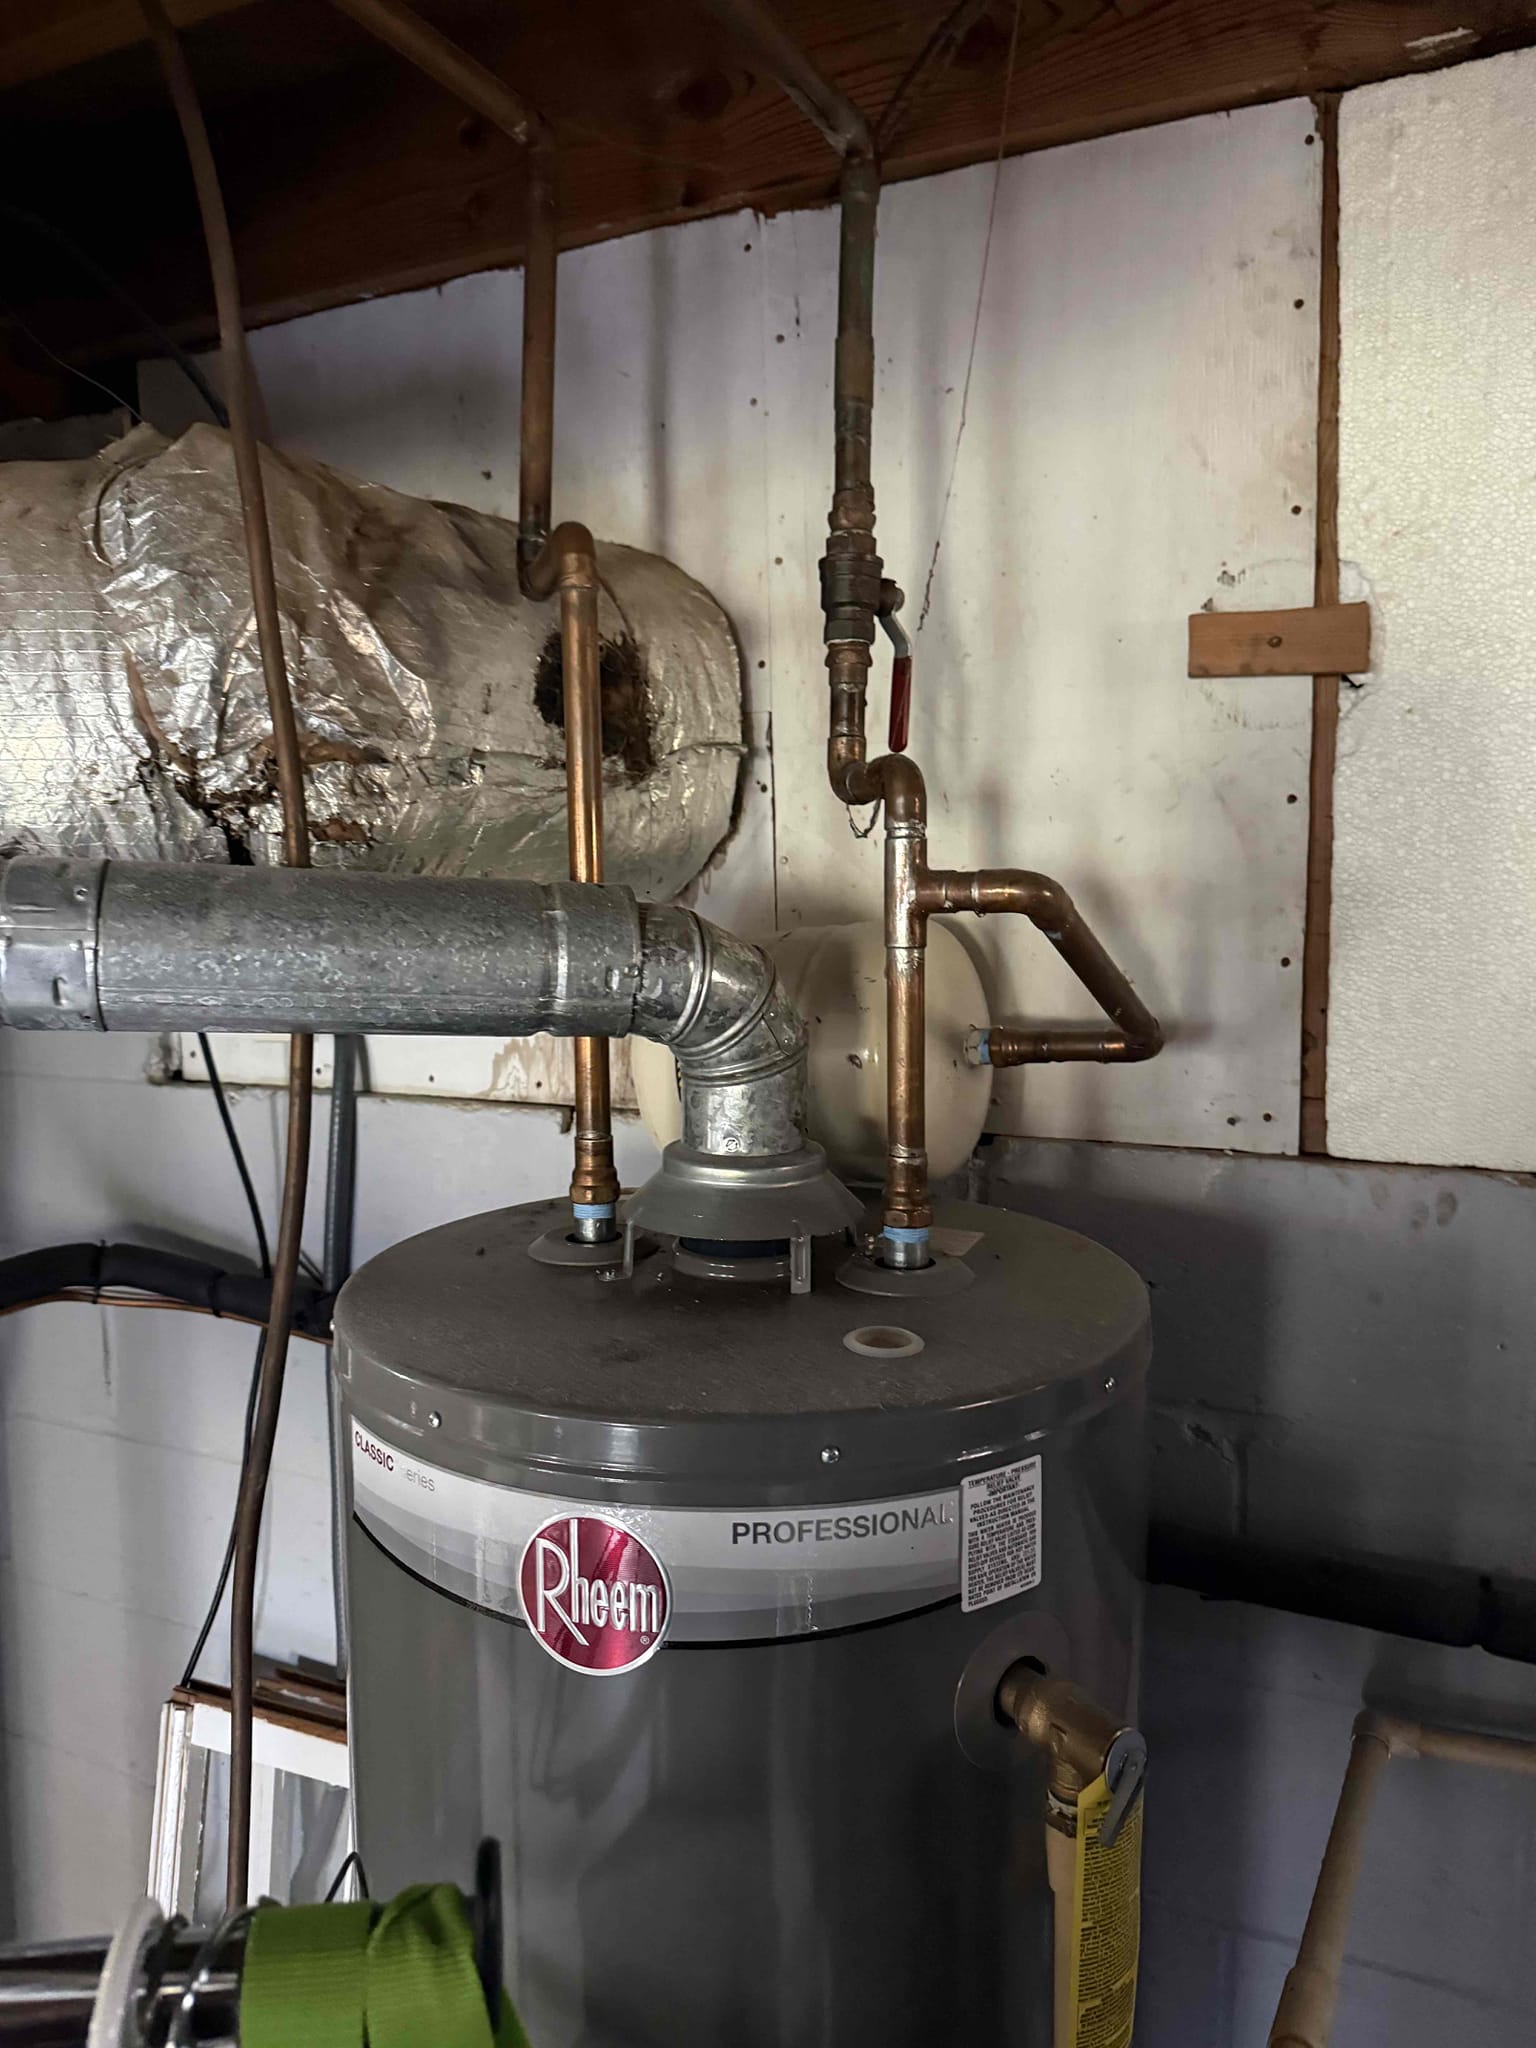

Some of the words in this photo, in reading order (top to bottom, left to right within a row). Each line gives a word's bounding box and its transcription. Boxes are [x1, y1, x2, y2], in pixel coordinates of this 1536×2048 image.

[354, 1431, 394, 1472] CLASSIC
[402, 1467, 436, 1492] eries
[968, 1471, 1005, 1487] TEMPERATURE
[732, 1504, 955, 1545] PROFESSIONAL
[986, 1525, 1014, 1538] TEMPERATURE
